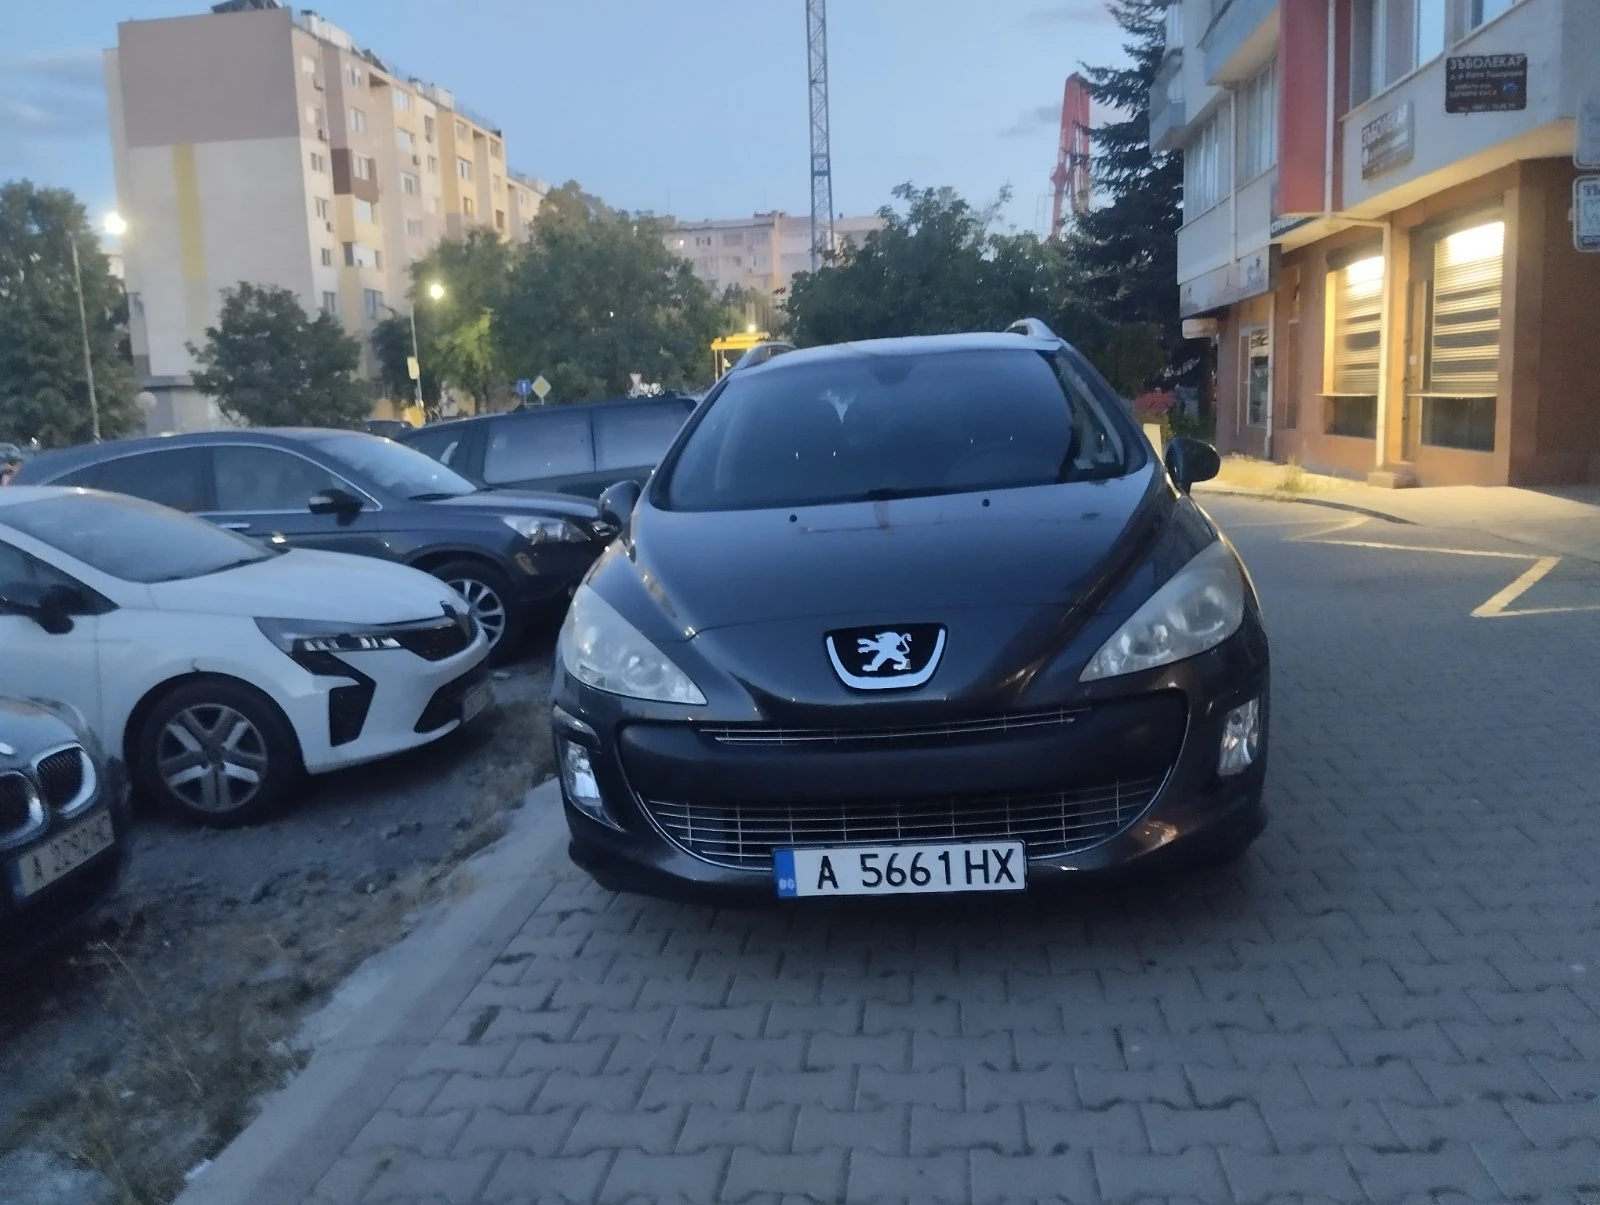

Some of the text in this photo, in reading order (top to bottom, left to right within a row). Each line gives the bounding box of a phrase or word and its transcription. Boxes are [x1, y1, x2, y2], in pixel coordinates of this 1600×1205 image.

[1449, 55, 1525, 70] ЗЪБОЛЕКАР
[817, 848, 1017, 890] A 5661 HX
